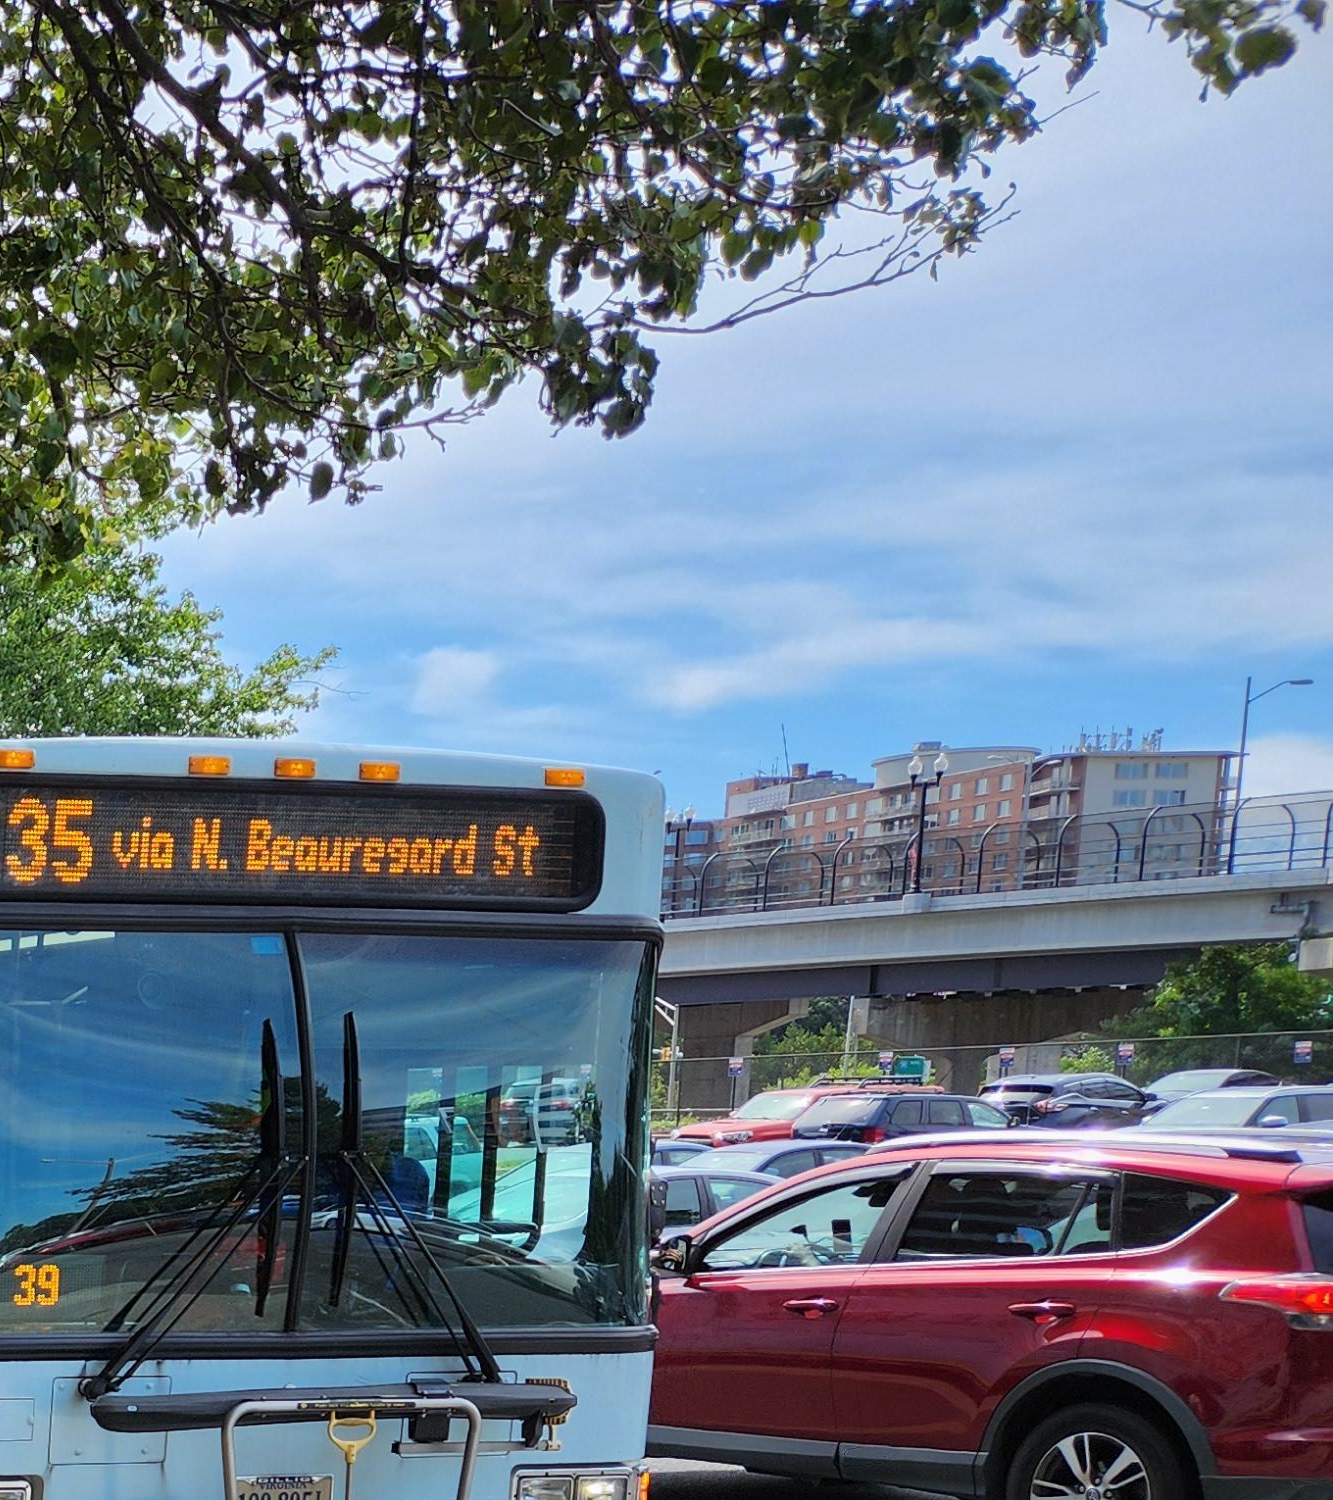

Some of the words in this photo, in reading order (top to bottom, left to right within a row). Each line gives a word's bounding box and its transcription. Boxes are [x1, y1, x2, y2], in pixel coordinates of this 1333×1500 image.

[5, 797, 93, 883] 35
[112, 816, 174, 869] via
[191, 817, 228, 870] N.
[246, 819, 477, 876] Beauregard
[493, 824, 541, 877] St
[13, 1264, 61, 1307] 39
[259, 1482, 308, 1490] VIRGINIA
